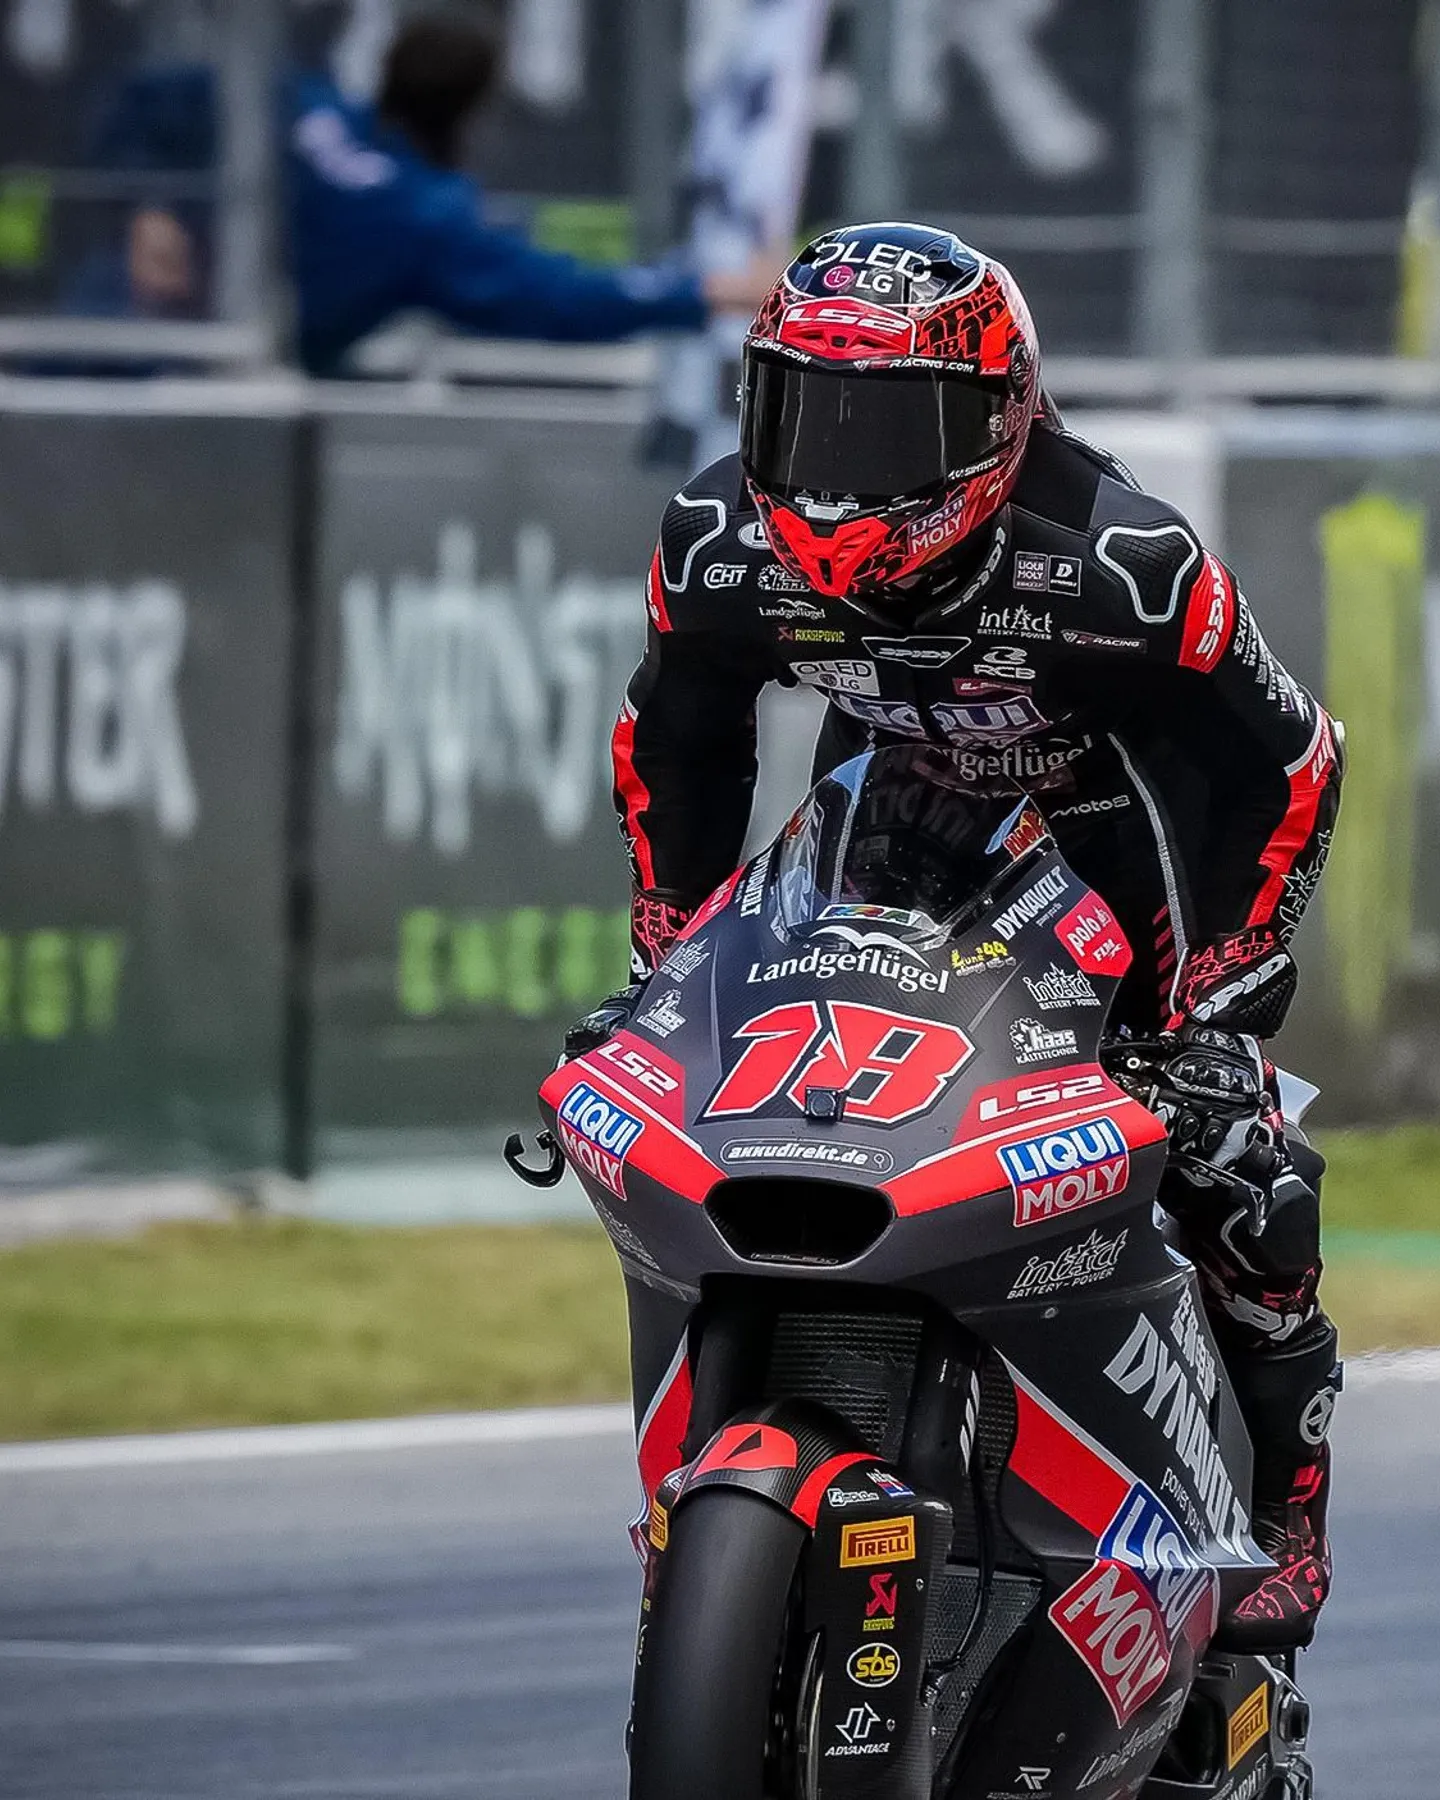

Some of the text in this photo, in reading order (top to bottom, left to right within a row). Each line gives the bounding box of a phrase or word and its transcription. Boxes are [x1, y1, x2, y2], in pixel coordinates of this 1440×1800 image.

[855, 270, 894, 295] LG
[786, 307, 911, 336] LS2
[911, 511, 962, 555] MOLY
[709, 568, 747, 585] CHT
[797, 660, 872, 678] OLED
[840, 677, 860, 691] LG
[973, 664, 1036, 681] RCB
[991, 865, 1070, 941] DYNAVOLT
[1066, 913, 1102, 957] polo
[746, 946, 950, 994] Landgeflügel
[597, 1041, 680, 1097] LS2
[702, 1000, 977, 1125] 18
[561, 1086, 639, 1156] LIQUI
[978, 1073, 1106, 1122] LS2
[560, 1125, 621, 1192] MOLY
[728, 1142, 869, 1165] akkudirekt.de
[1007, 1120, 1120, 1184] LIQUI
[1021, 1158, 1126, 1222] MOLY
[1102, 1312, 1256, 1564] DYNAVOLT
[847, 1525, 910, 1559] PIRELLI
[1062, 1563, 1167, 1712] MOLY
